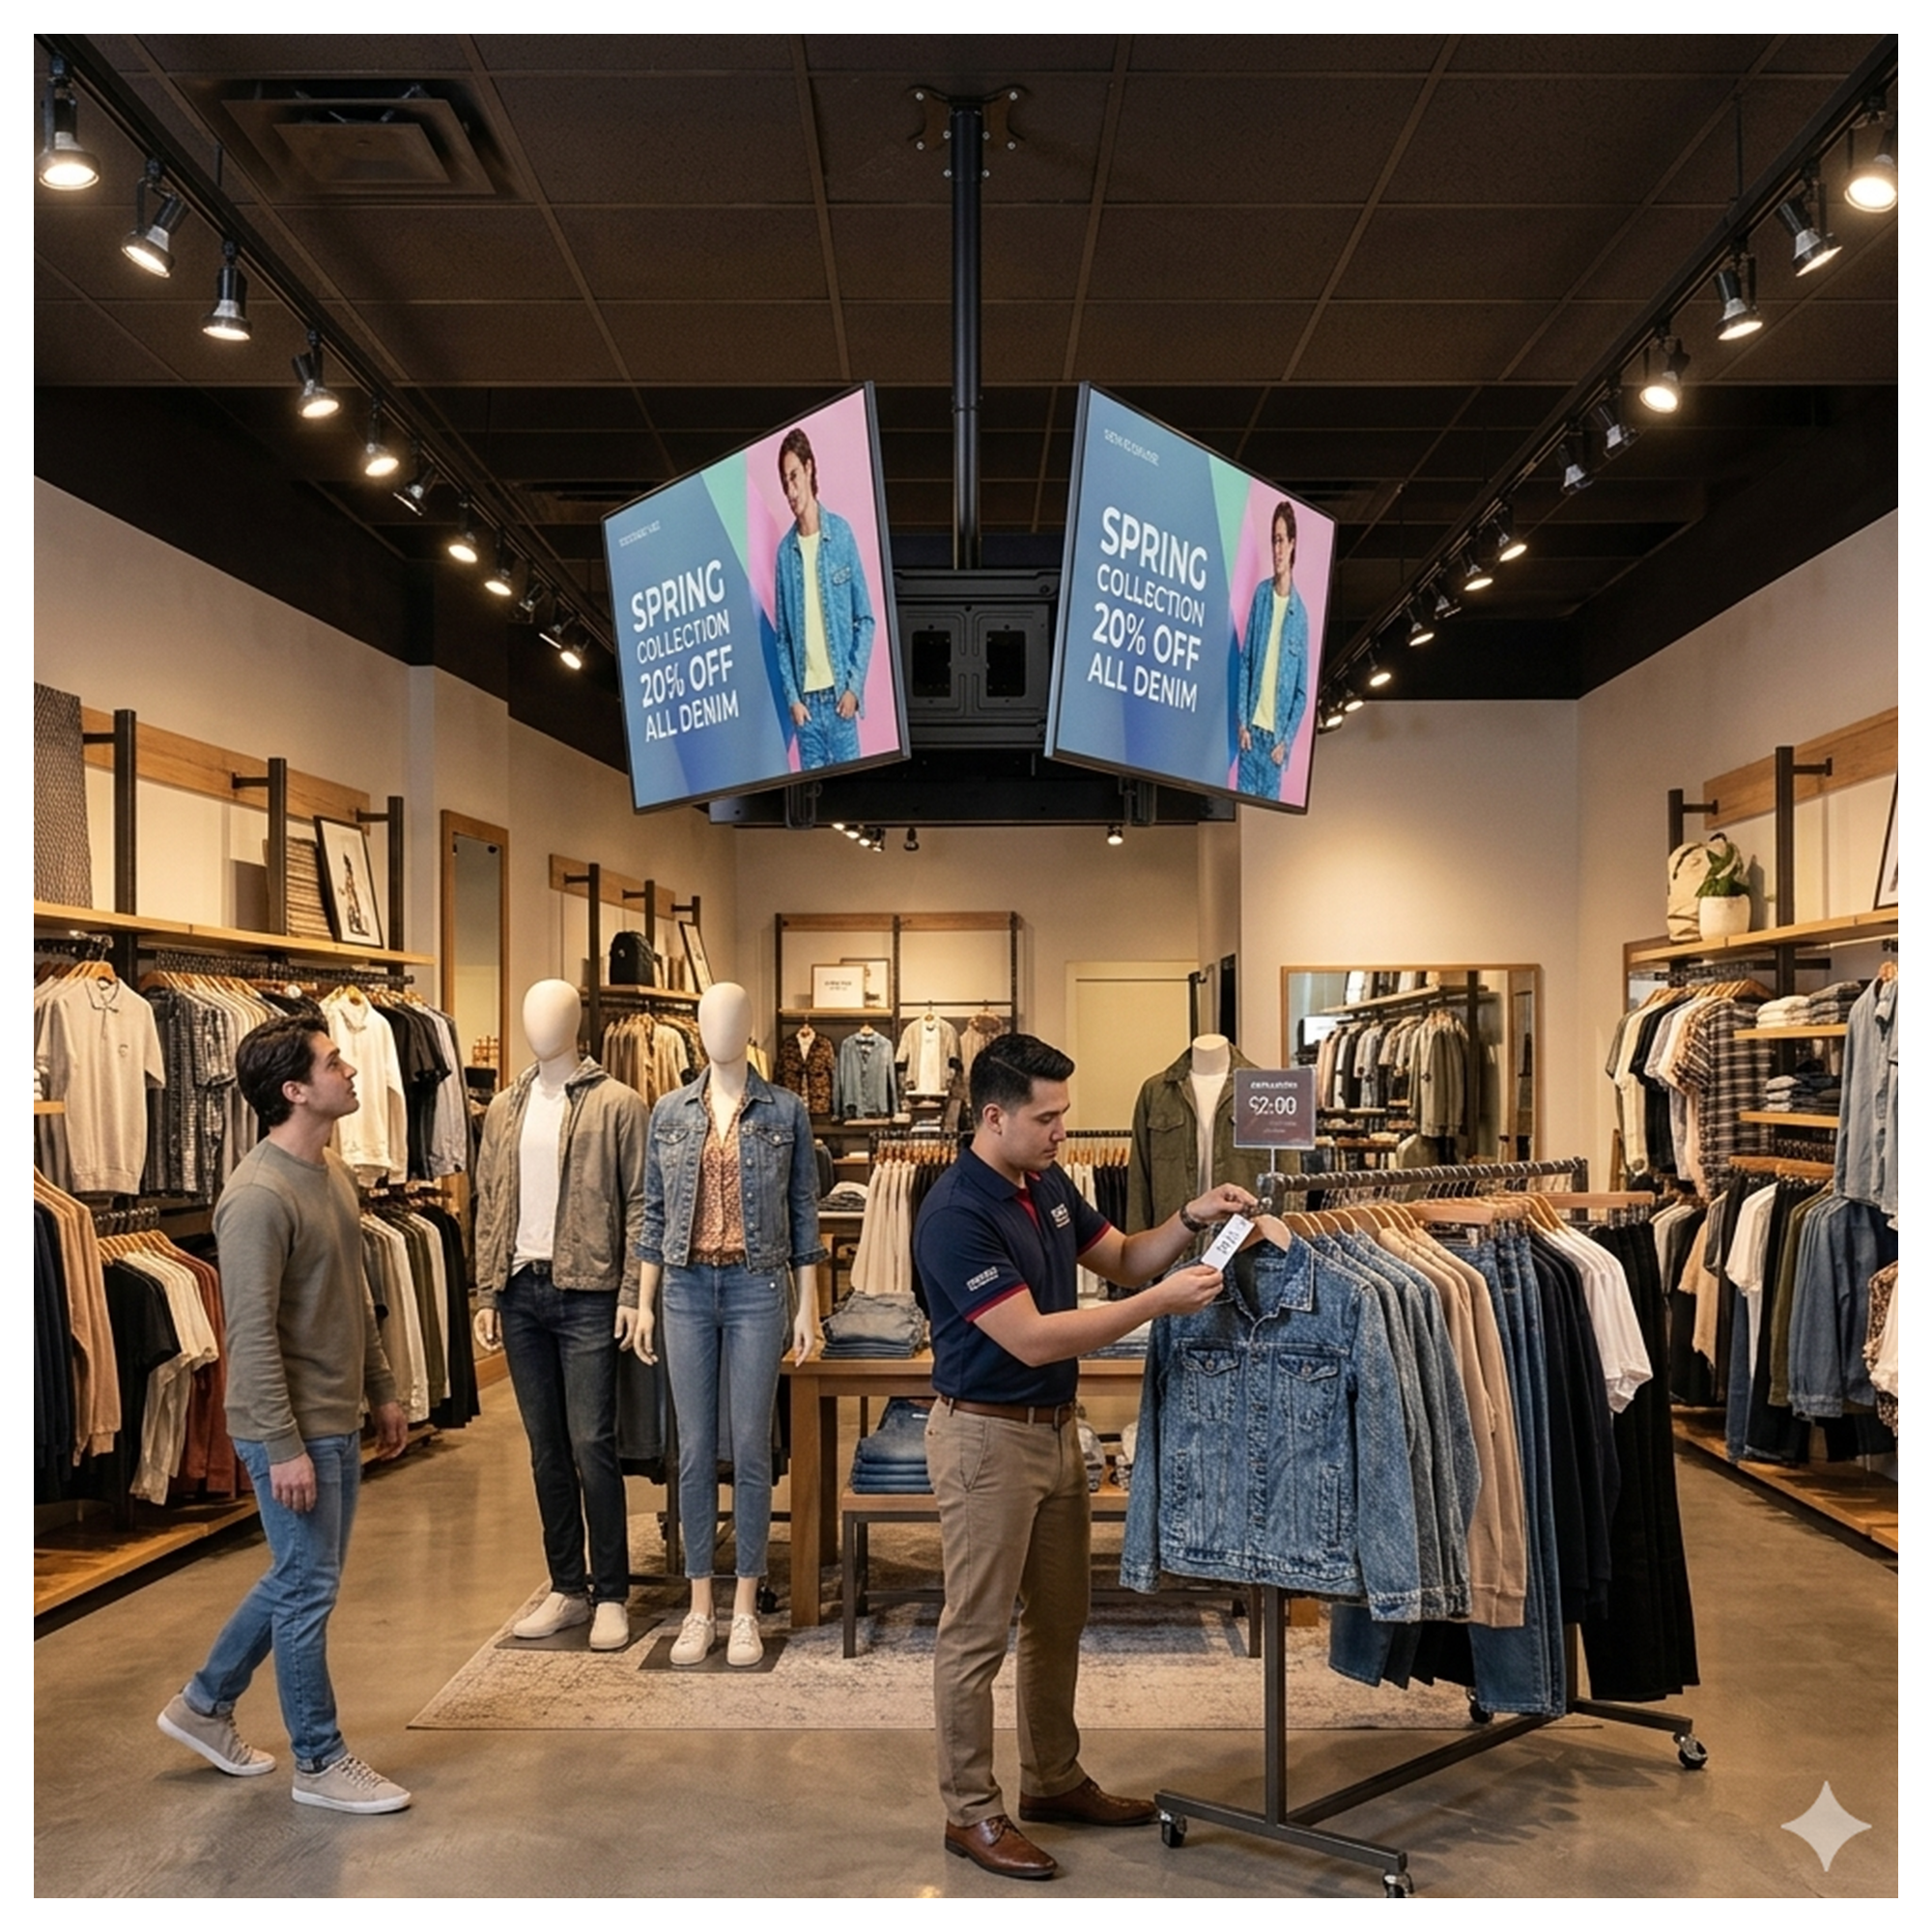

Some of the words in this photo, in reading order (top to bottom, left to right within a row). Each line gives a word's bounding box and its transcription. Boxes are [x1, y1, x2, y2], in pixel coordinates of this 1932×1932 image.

[1100, 506, 1208, 591] SPRING
[632, 559, 725, 633] SPRING
[1096, 563, 1205, 628] COLLECTION
[637, 610, 730, 665] COLLECTION
[1093, 602, 1146, 656] 20%
[1152, 624, 1202, 670] OFF
[639, 663, 685, 709] 20%
[689, 644, 734, 692] OFF
[1088, 652, 1127, 694] ALL
[1133, 665, 1198, 713] DENIM
[645, 707, 678, 743] ALL
[679, 691, 739, 732] DENIM
